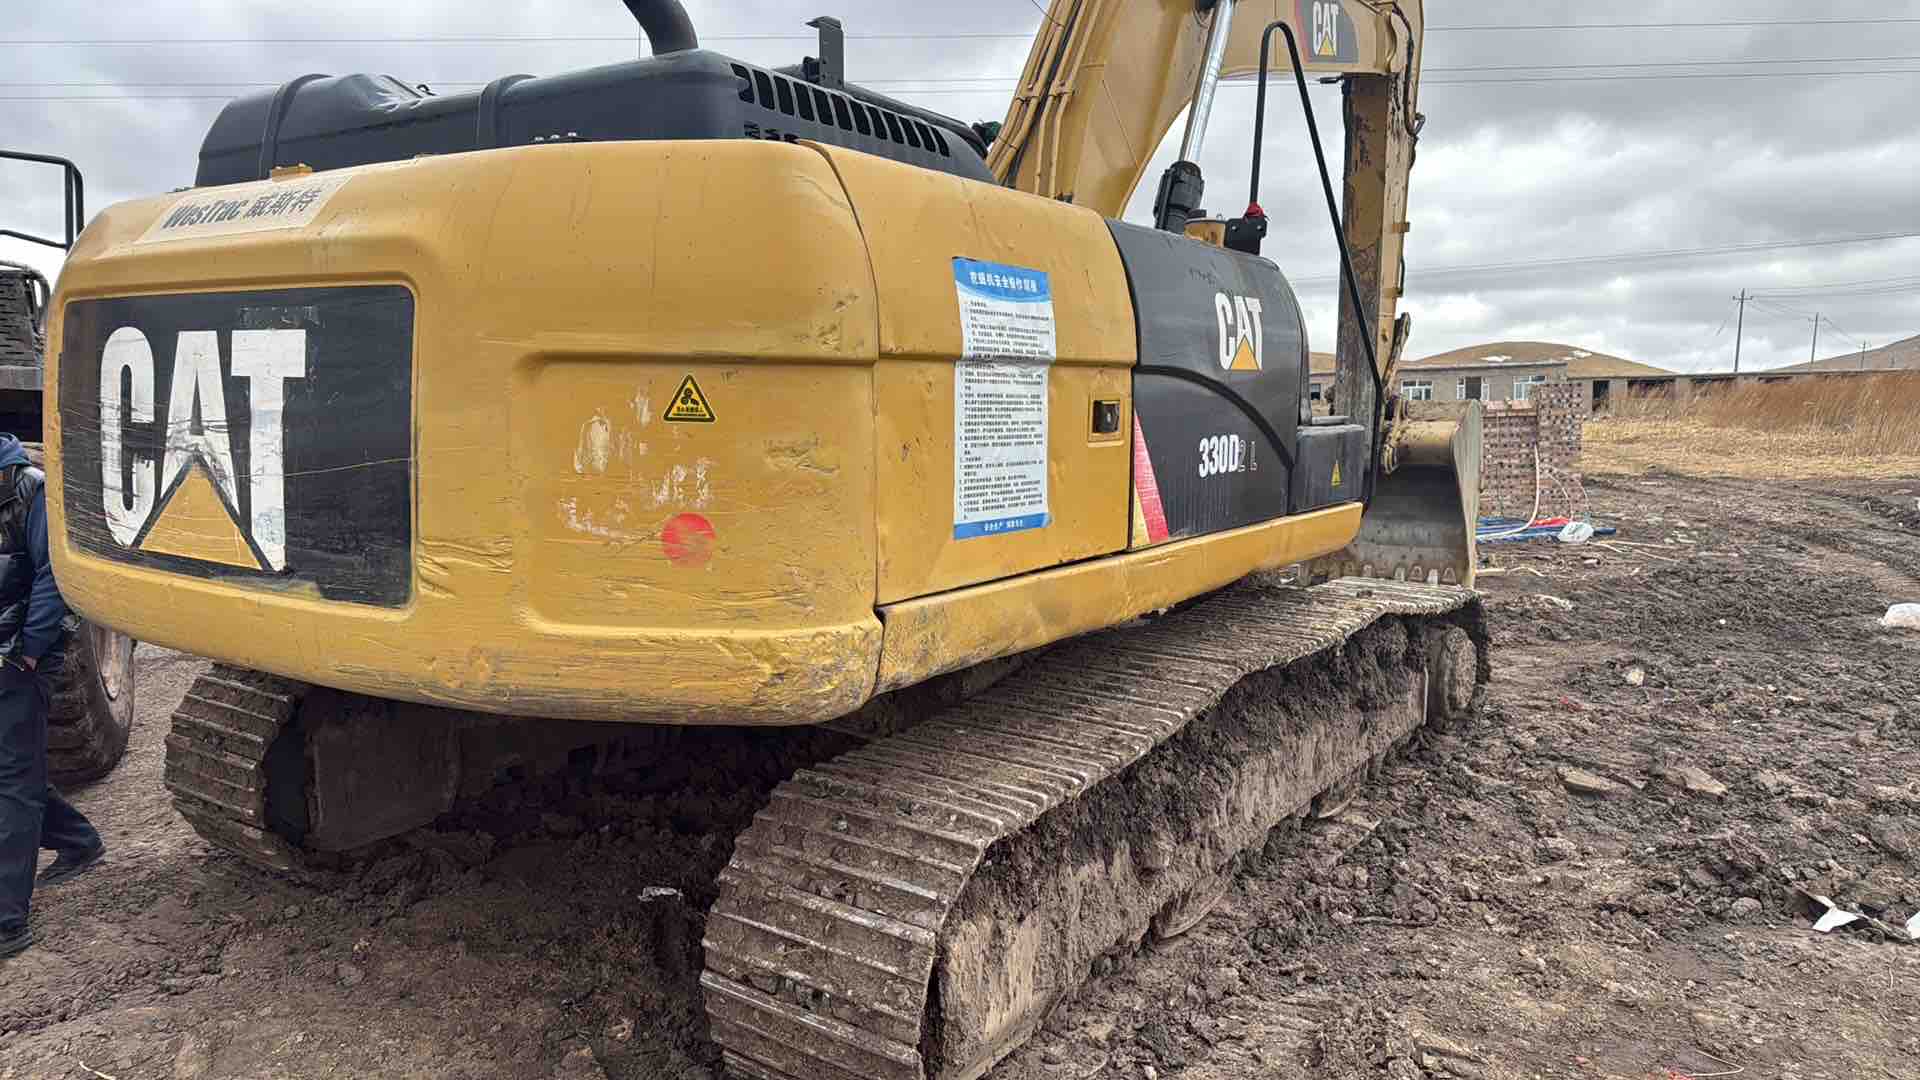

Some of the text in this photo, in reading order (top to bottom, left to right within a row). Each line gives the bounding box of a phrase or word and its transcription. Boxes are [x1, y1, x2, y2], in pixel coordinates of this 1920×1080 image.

[1313, 1, 1338, 56] CAT
[244, 189, 321, 219] 威斯特
[1215, 292, 1262, 369] CAT
[101, 326, 307, 573] CAT
